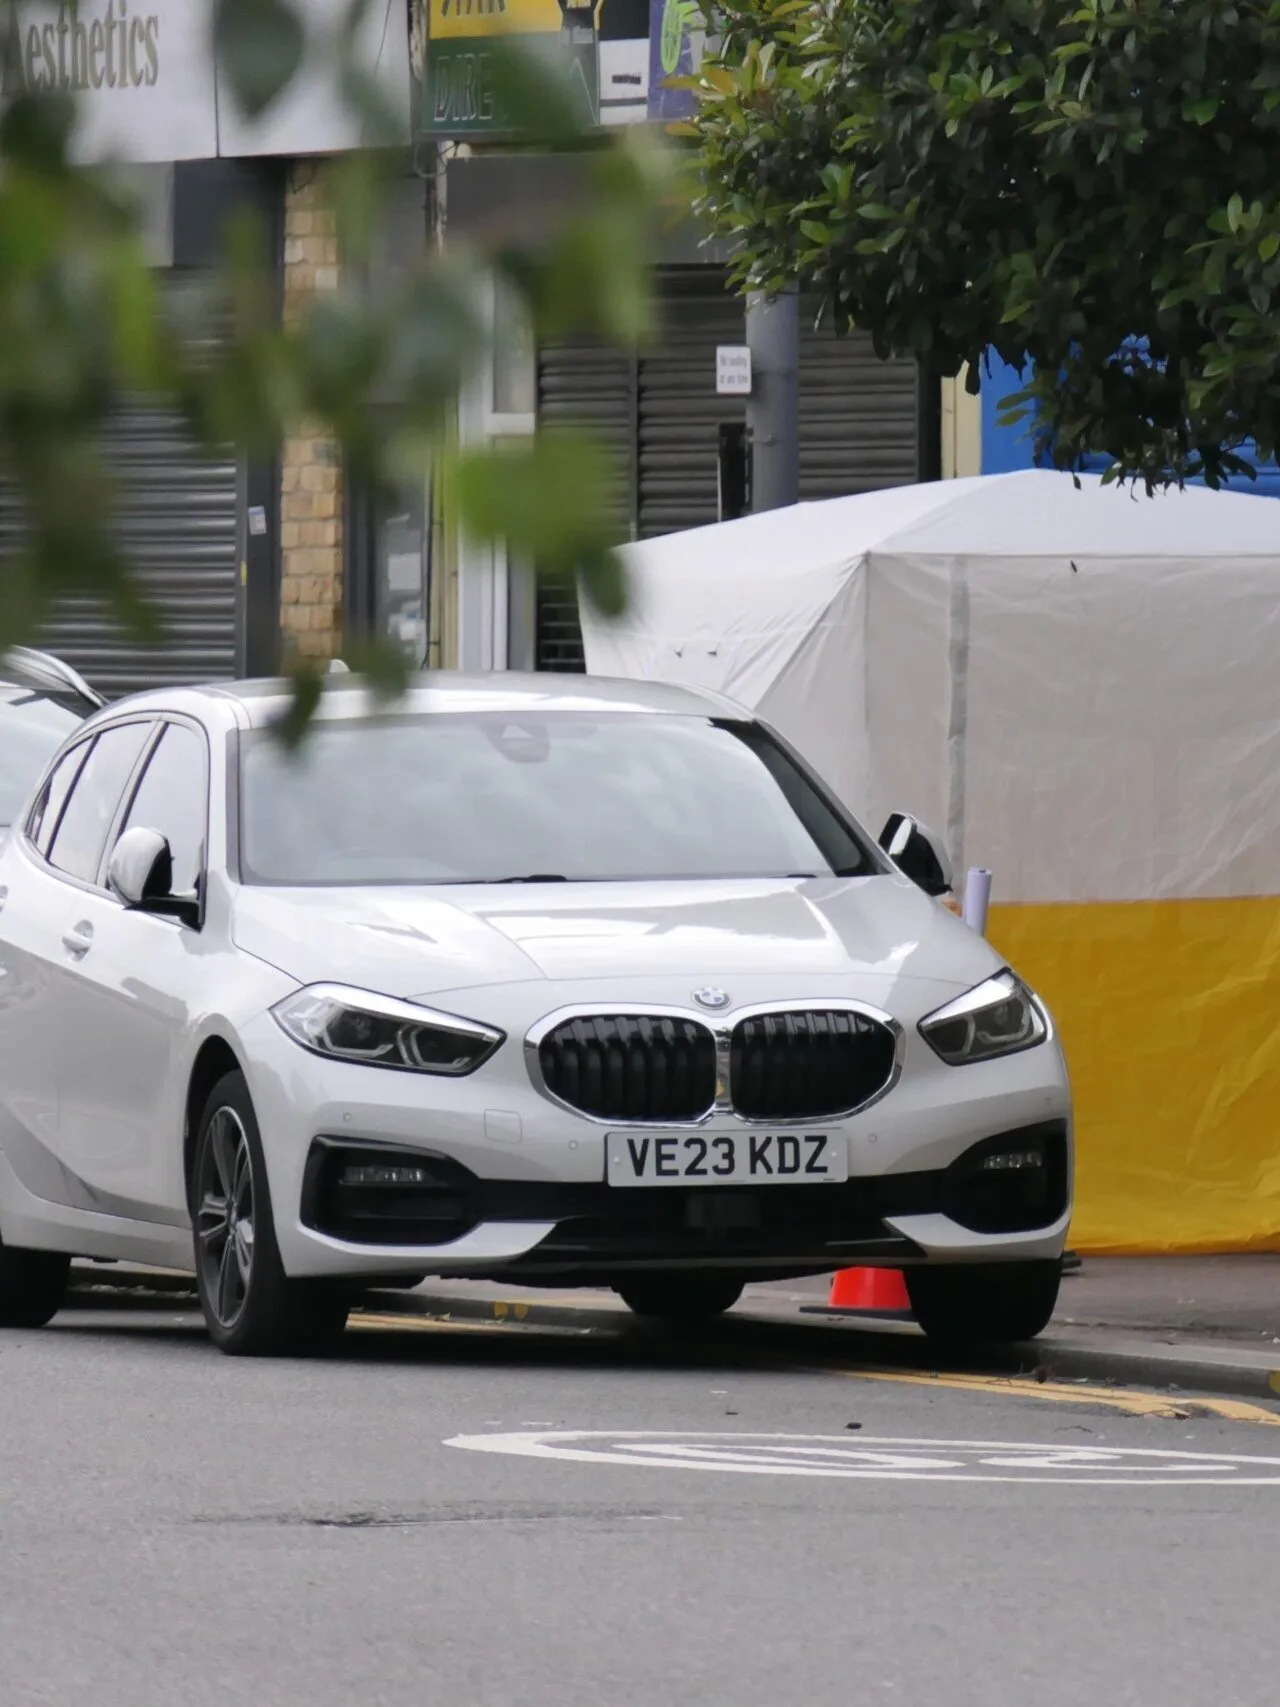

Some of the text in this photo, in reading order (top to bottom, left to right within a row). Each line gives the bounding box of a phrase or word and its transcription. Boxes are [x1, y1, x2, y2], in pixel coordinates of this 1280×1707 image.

[627, 1135, 828, 1177] VE23 KDZ
[612, 1443, 1238, 1470] 20
